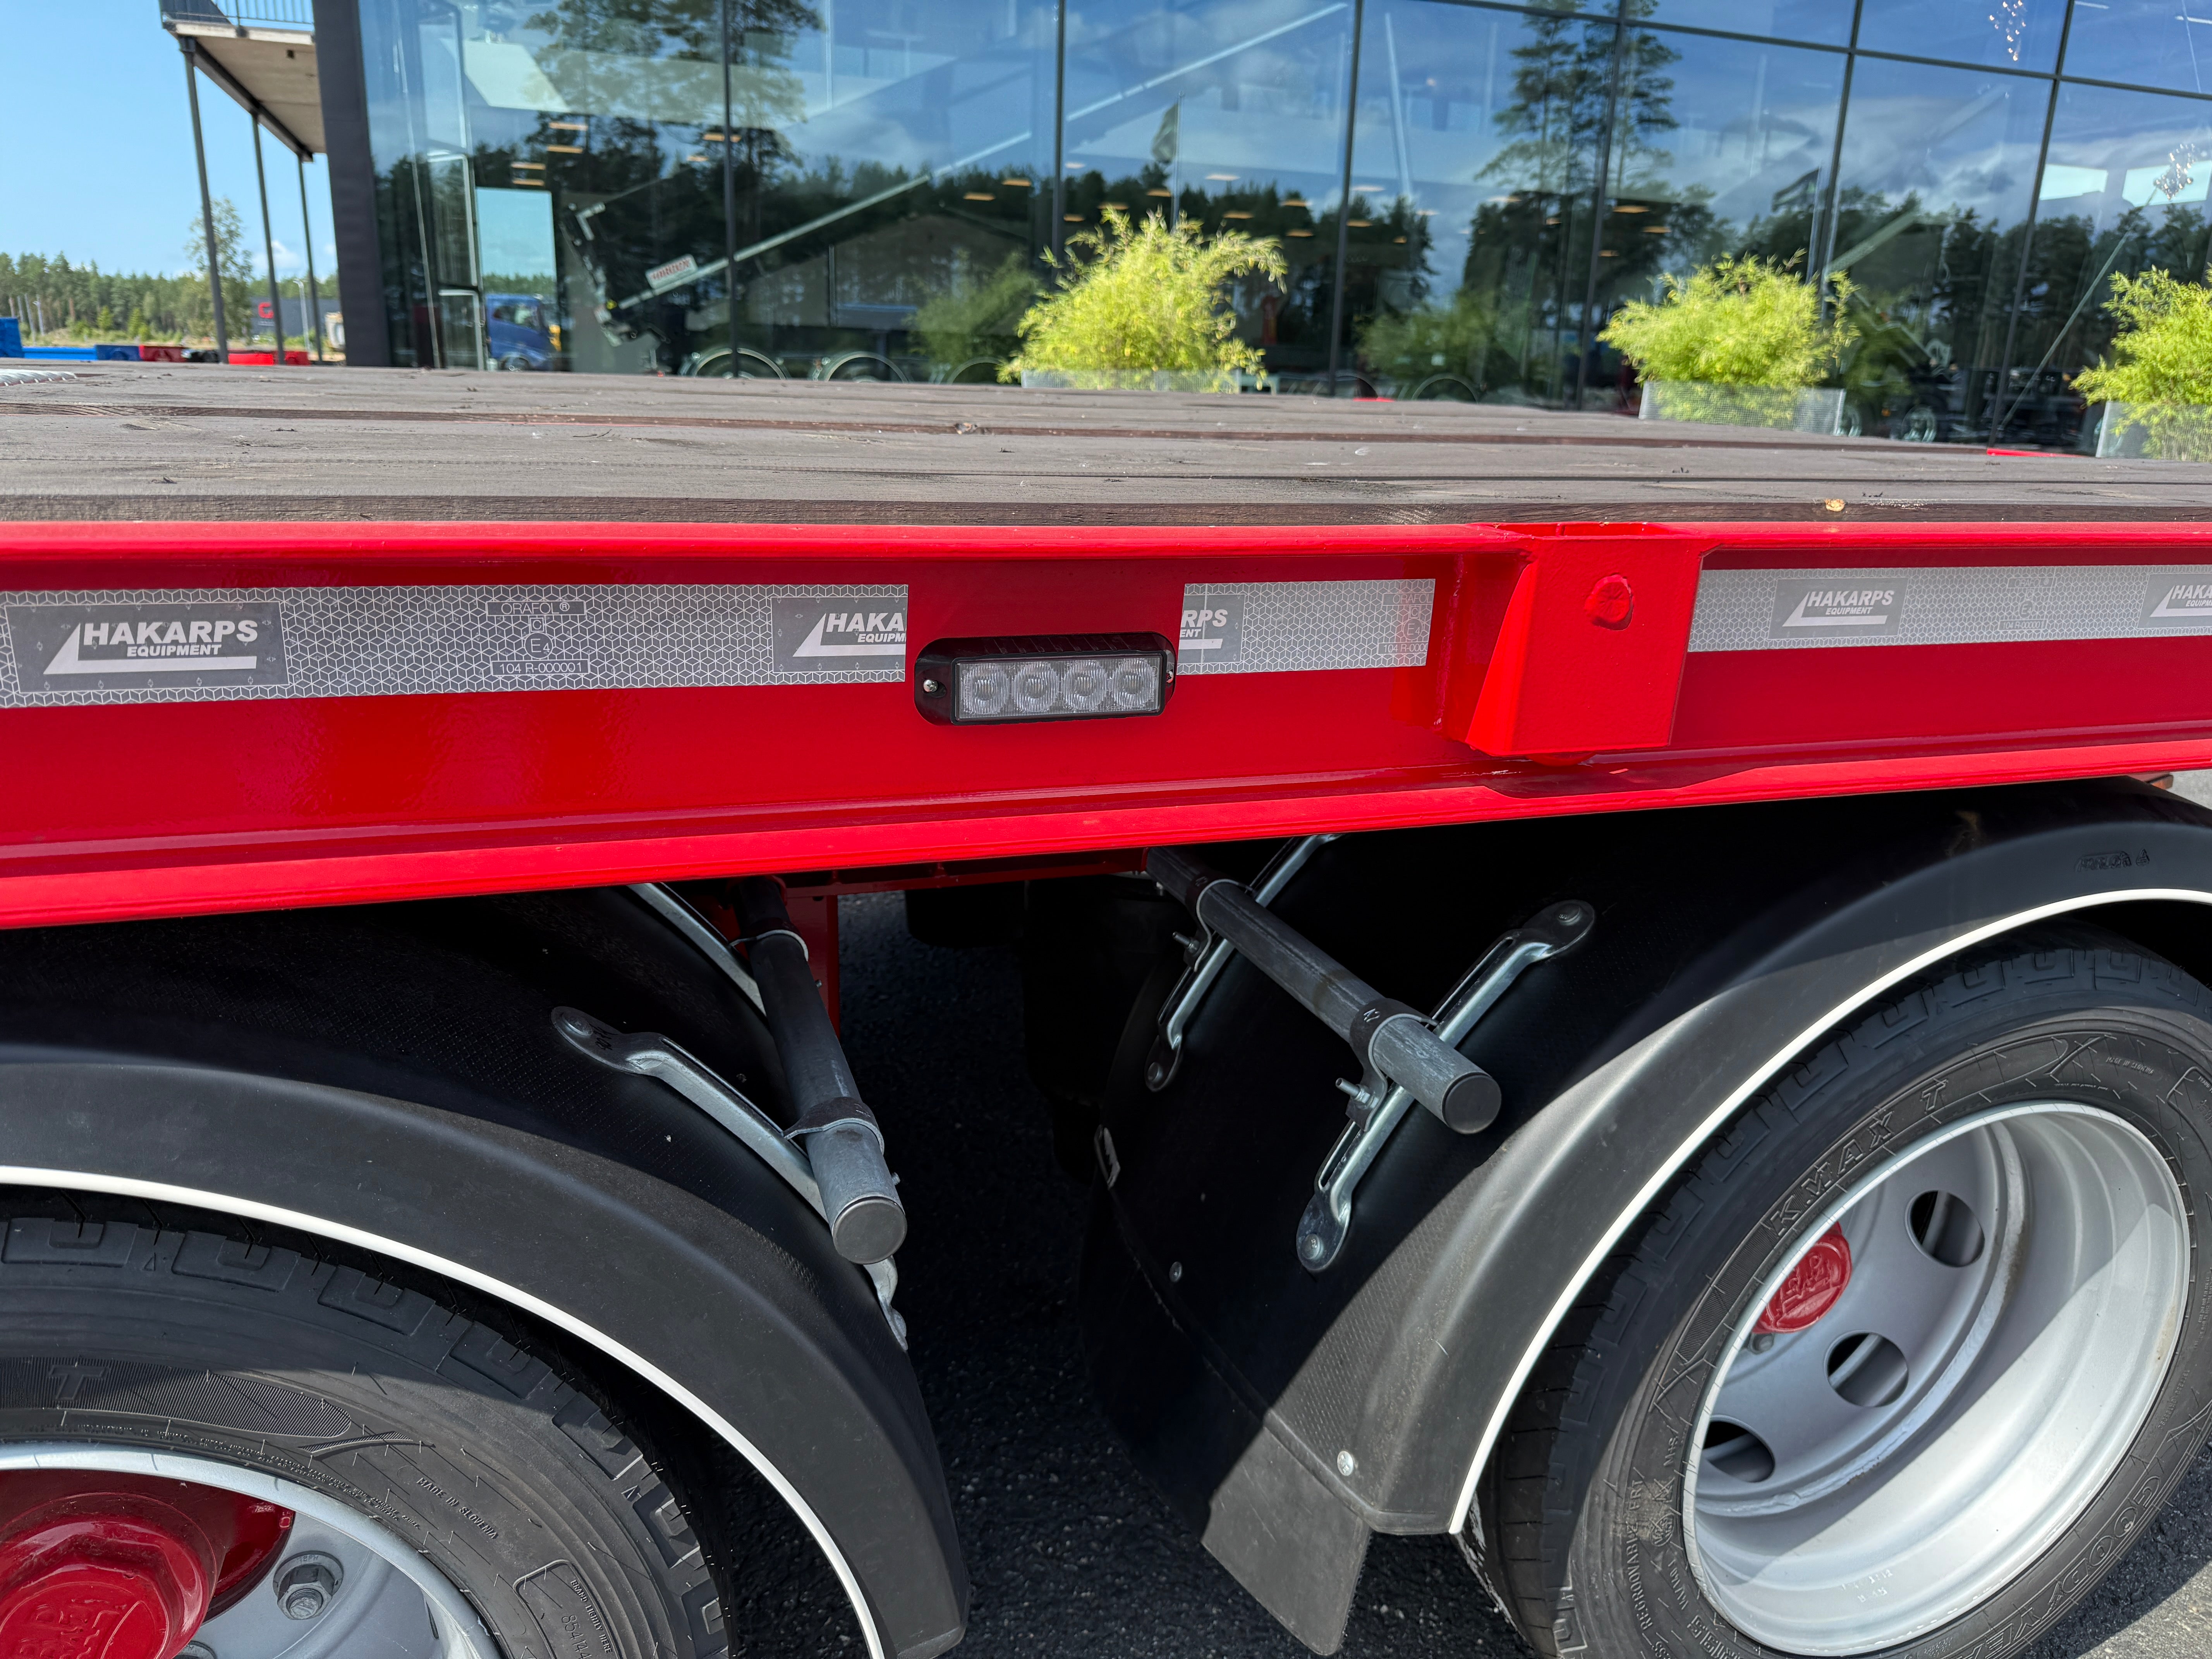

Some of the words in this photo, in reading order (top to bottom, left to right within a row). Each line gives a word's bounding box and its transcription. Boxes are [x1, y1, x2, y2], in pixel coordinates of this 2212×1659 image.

[1807, 590, 1894, 607] HAKARPS
[1826, 607, 1873, 615] EQUIPMENT
[83, 620, 258, 645] HAKARPS
[127, 644, 222, 657] EQUIPMENT
[500, 663, 522, 674] 104
[526, 662, 581, 673] R-000001
[1770, 1110, 1895, 1237] KMAX
[416, 1477, 446, 1498] MADE
[446, 1497, 459, 1506] IN
[459, 1507, 498, 1539] SLOVENIA
[570, 1580, 588, 1602] BRAND
[585, 1605, 603, 1630] LIGHTLY
[599, 1634, 613, 1654] HERE
